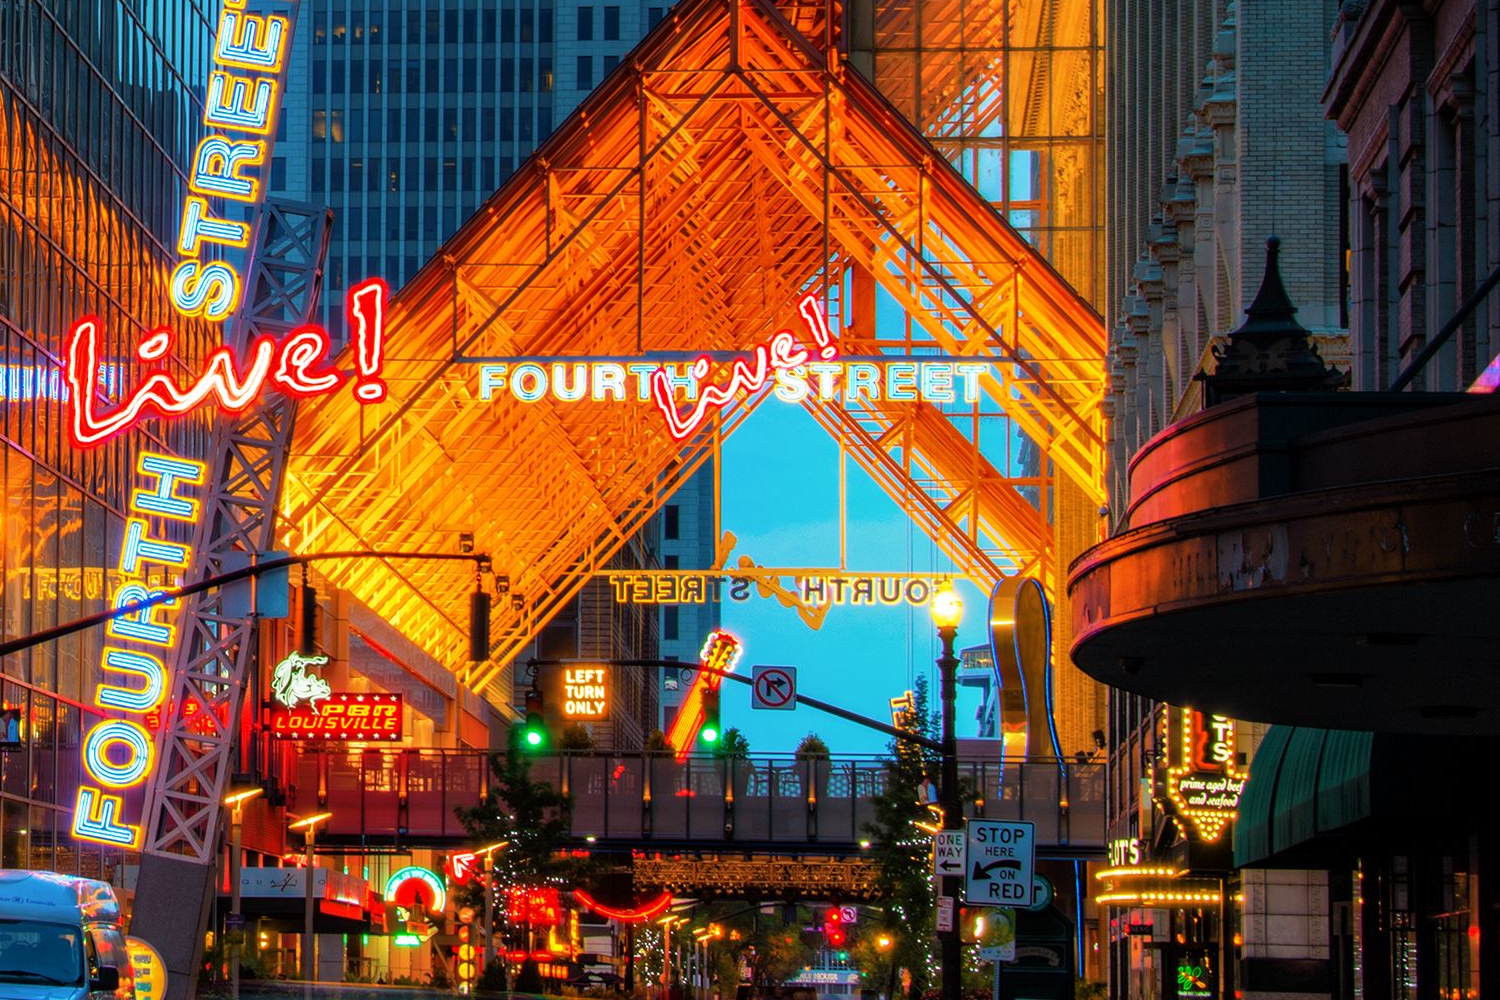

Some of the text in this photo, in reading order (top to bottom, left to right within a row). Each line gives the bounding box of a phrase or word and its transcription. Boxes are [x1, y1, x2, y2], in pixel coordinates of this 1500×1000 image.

[68, 277, 388, 448] Live!
[652, 293, 837, 442] Live!
[479, 362, 988, 403] FOURTH STREET
[72, 451, 206, 849] FOURTH
[565, 669, 605, 684] LEFT
[564, 685, 605, 700] TURN
[321, 704, 397, 717] PBR
[565, 700, 605, 716] ONLY
[276, 717, 397, 730] LOUISVILLE
[1180, 777, 1206, 792] prime
[1206, 778, 1227, 794] aged
[1188, 792, 1239, 809] and seafood
[938, 834, 962, 846] ONE
[976, 827, 1025, 844] STOP
[937, 847, 963, 858] WAY
[985, 847, 1014, 857] HERE
[1000, 870, 1015, 880] ON
[989, 883, 1025, 899] RED
